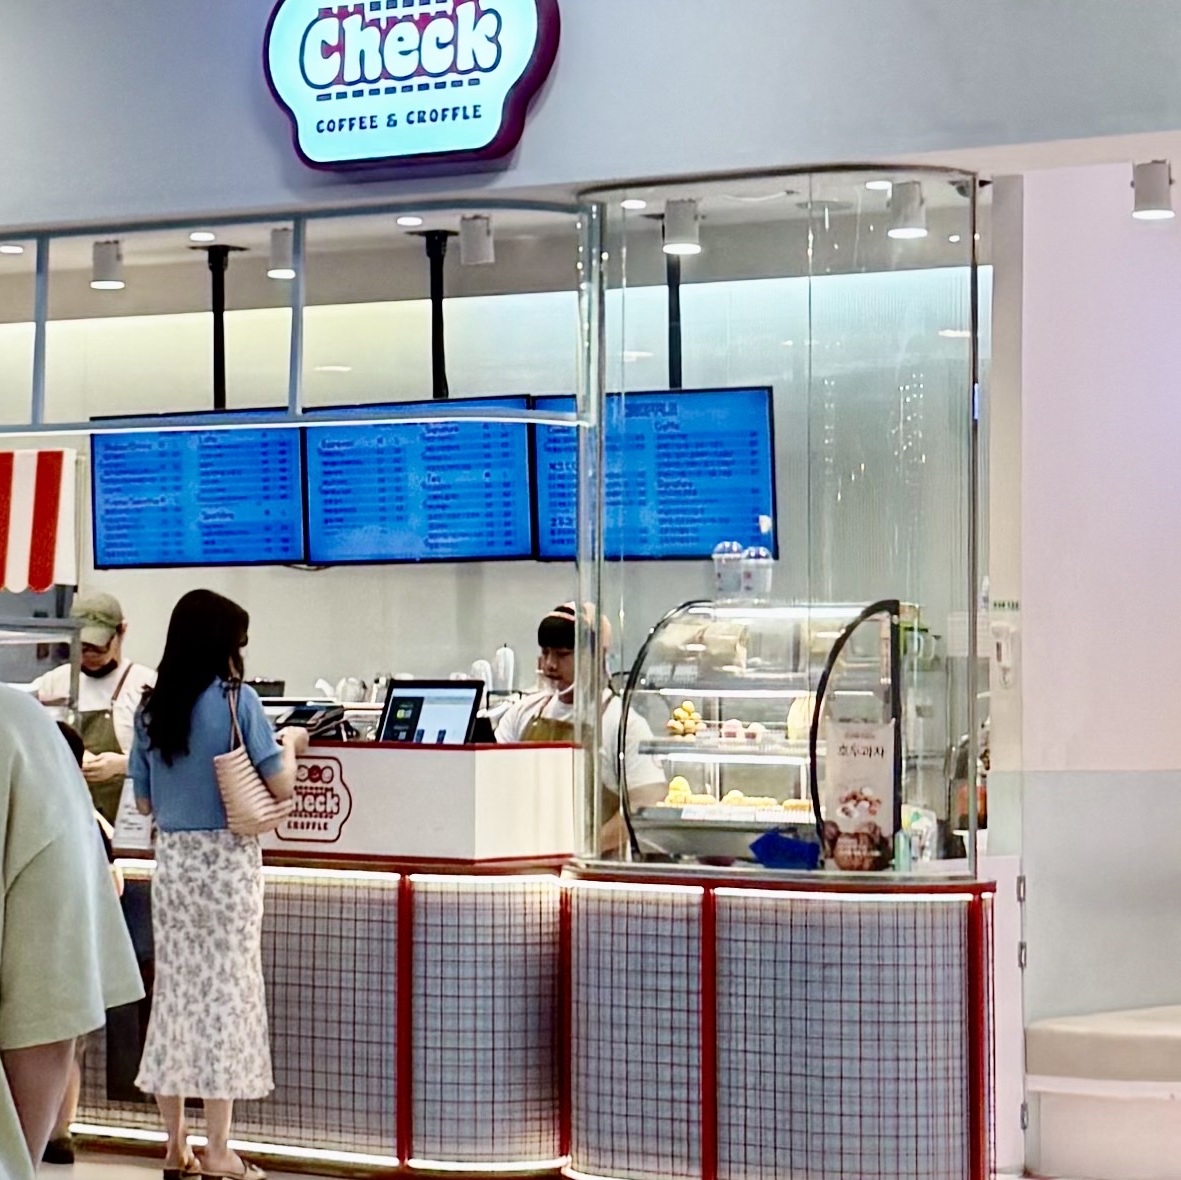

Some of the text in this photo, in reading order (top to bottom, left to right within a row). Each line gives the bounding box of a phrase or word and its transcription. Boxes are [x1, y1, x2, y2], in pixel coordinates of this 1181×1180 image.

[300, 1, 503, 88] Check
[316, 104, 482, 133] COFFEE & CROFFLE
[292, 789, 340, 815] heck
